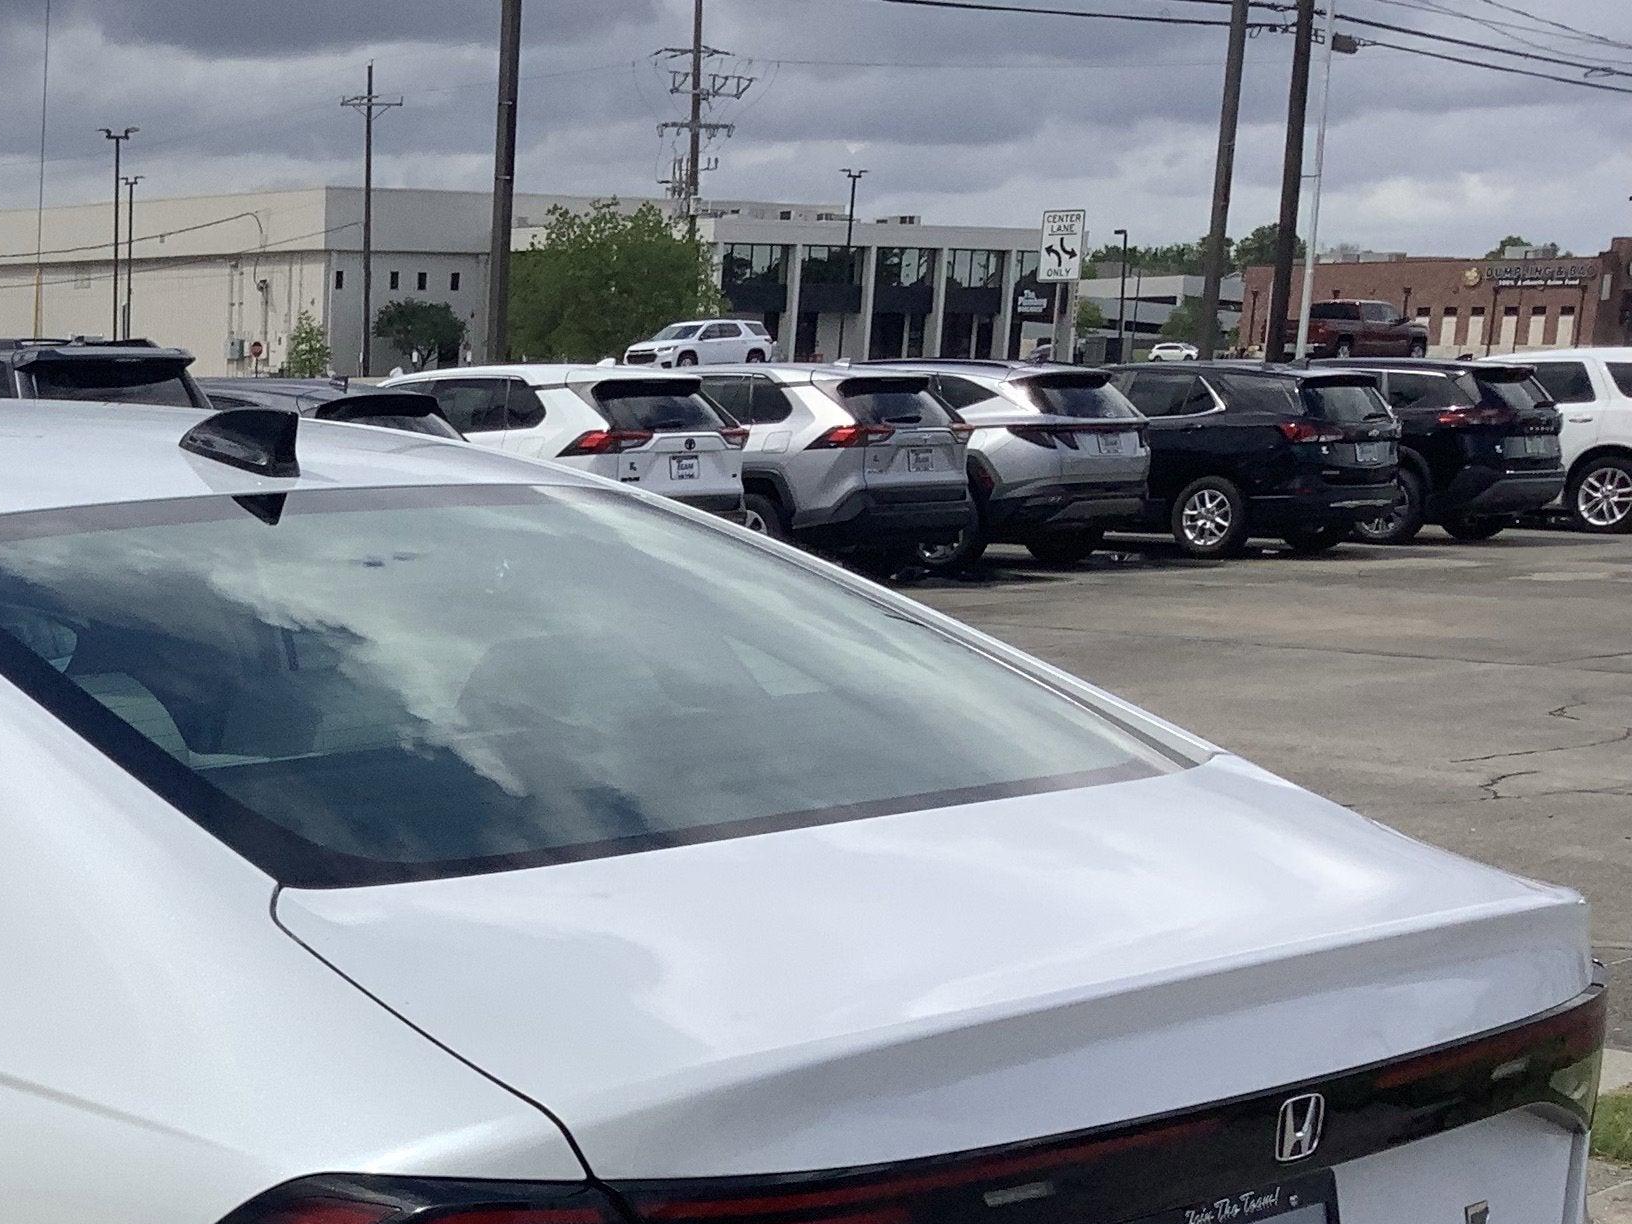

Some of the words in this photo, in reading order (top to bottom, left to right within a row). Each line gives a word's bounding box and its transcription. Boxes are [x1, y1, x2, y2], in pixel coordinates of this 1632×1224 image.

[1046, 213, 1082, 223] CENTER
[1051, 224, 1075, 233] LANE
[1046, 267, 1071, 277] ONLY
[1215, 1198, 1240, 1222] The
[1239, 1187, 1281, 1216] Team!
